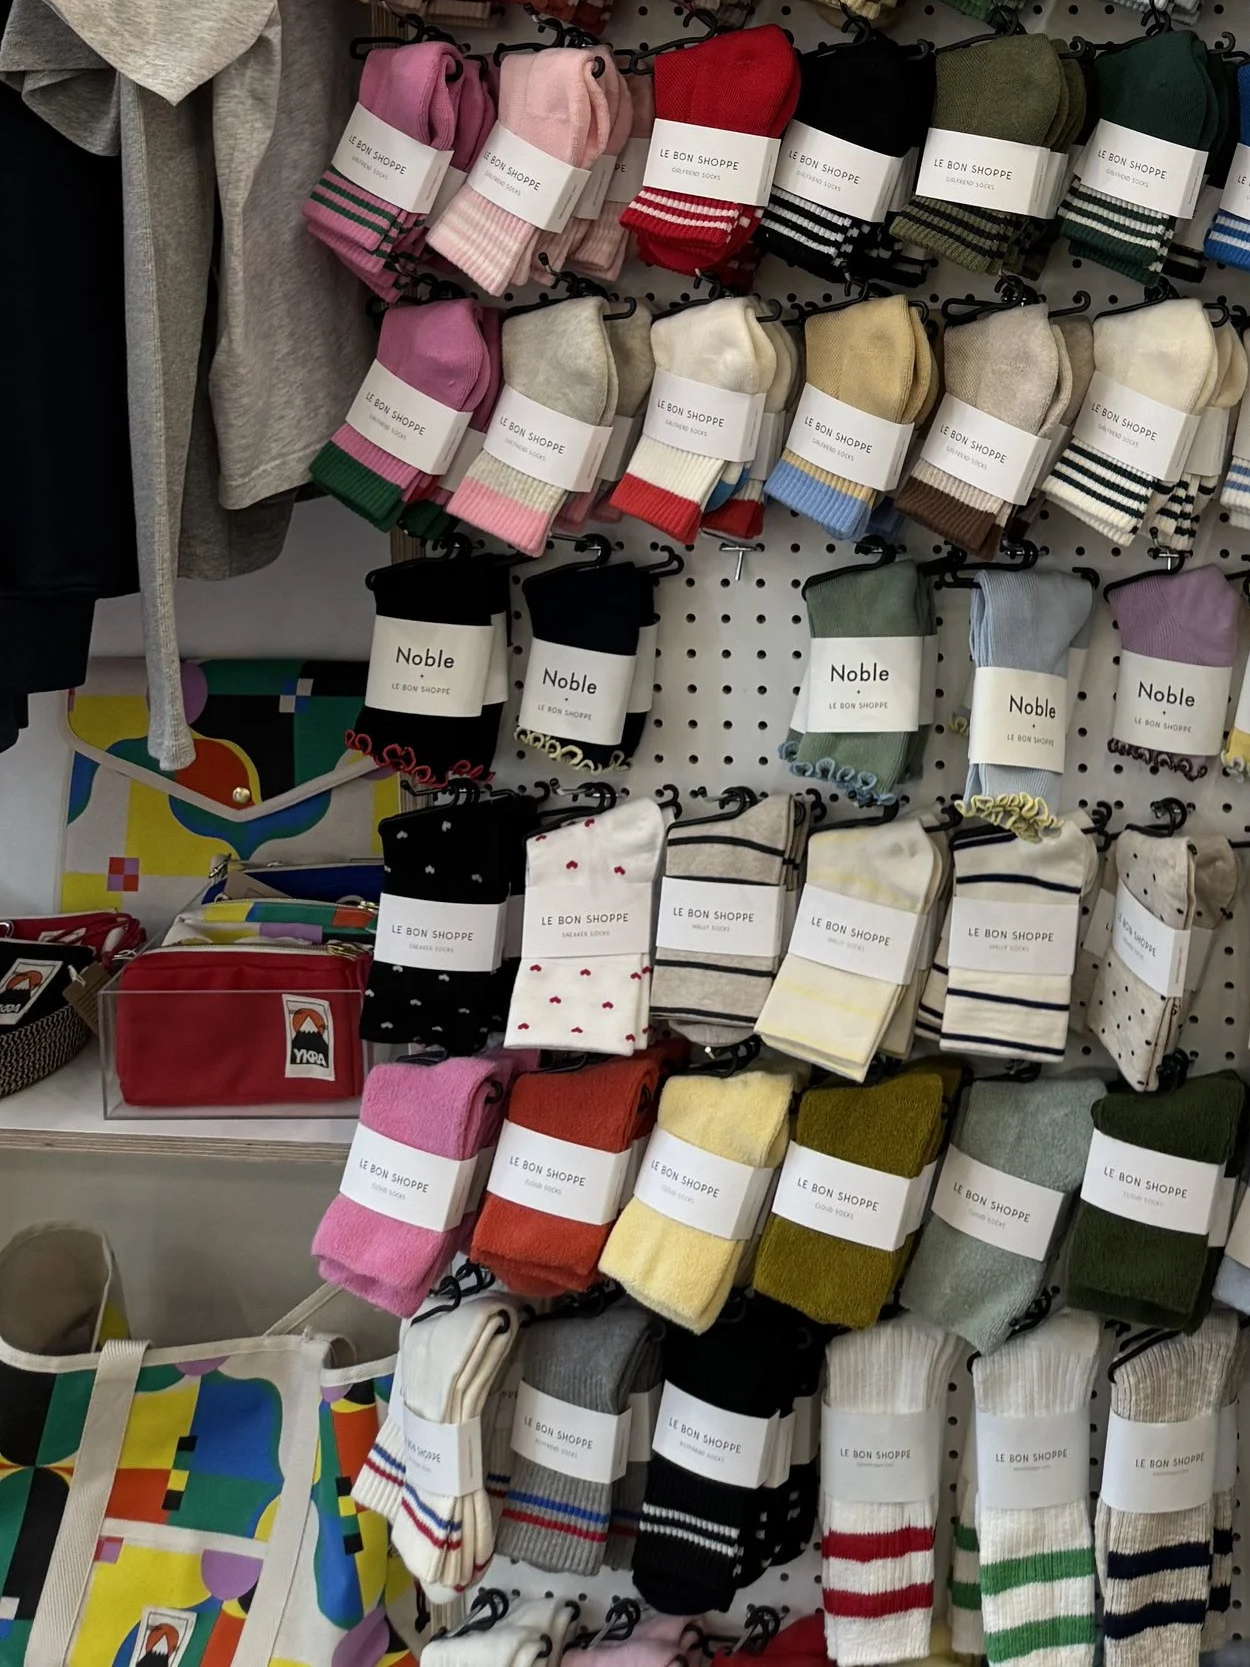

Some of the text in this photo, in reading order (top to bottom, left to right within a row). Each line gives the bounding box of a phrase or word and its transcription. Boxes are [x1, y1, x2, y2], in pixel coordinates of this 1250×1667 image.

[396, 647, 455, 670] Noble
[829, 663, 890, 684] Noble
[1138, 681, 1195, 707] Noble
[542, 913, 628, 925] LE BON SHOPPE
[293, 1047, 328, 1068] YKRA
[841, 1449, 910, 1459] LE BON SHOPPE
